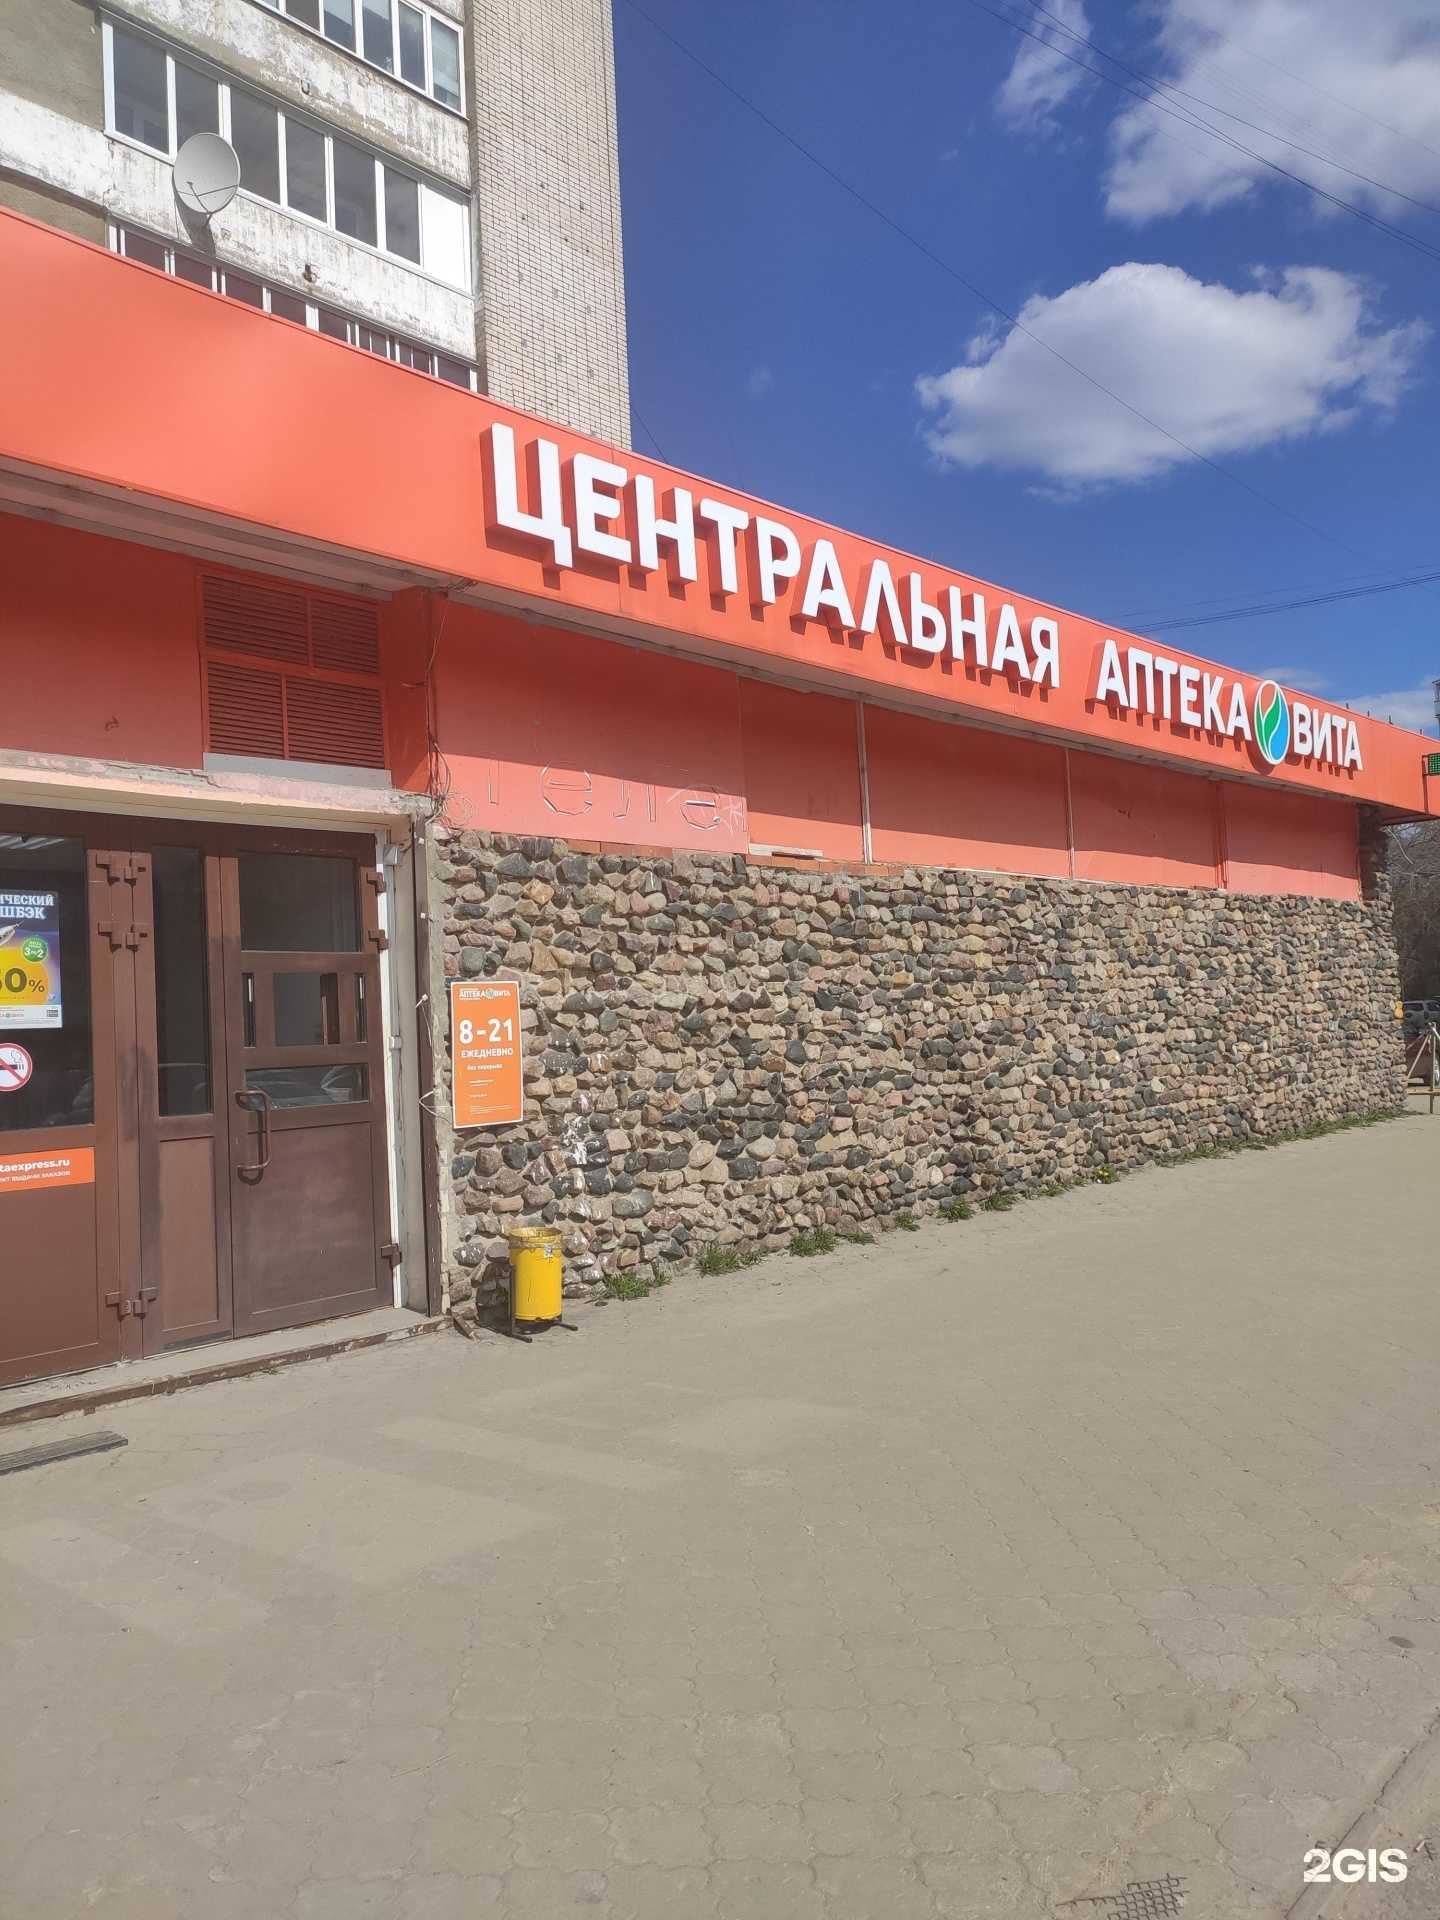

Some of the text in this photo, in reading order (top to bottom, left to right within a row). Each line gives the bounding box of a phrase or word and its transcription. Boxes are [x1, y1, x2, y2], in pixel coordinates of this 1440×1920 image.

[491, 422, 1364, 771] ЦЕНТРАЛЬНАЯ АПТЕКА ВИТА
[0, 967, 45, 993] 0%
[461, 1048, 513, 1058] ЕЖЕДНЕВНО
